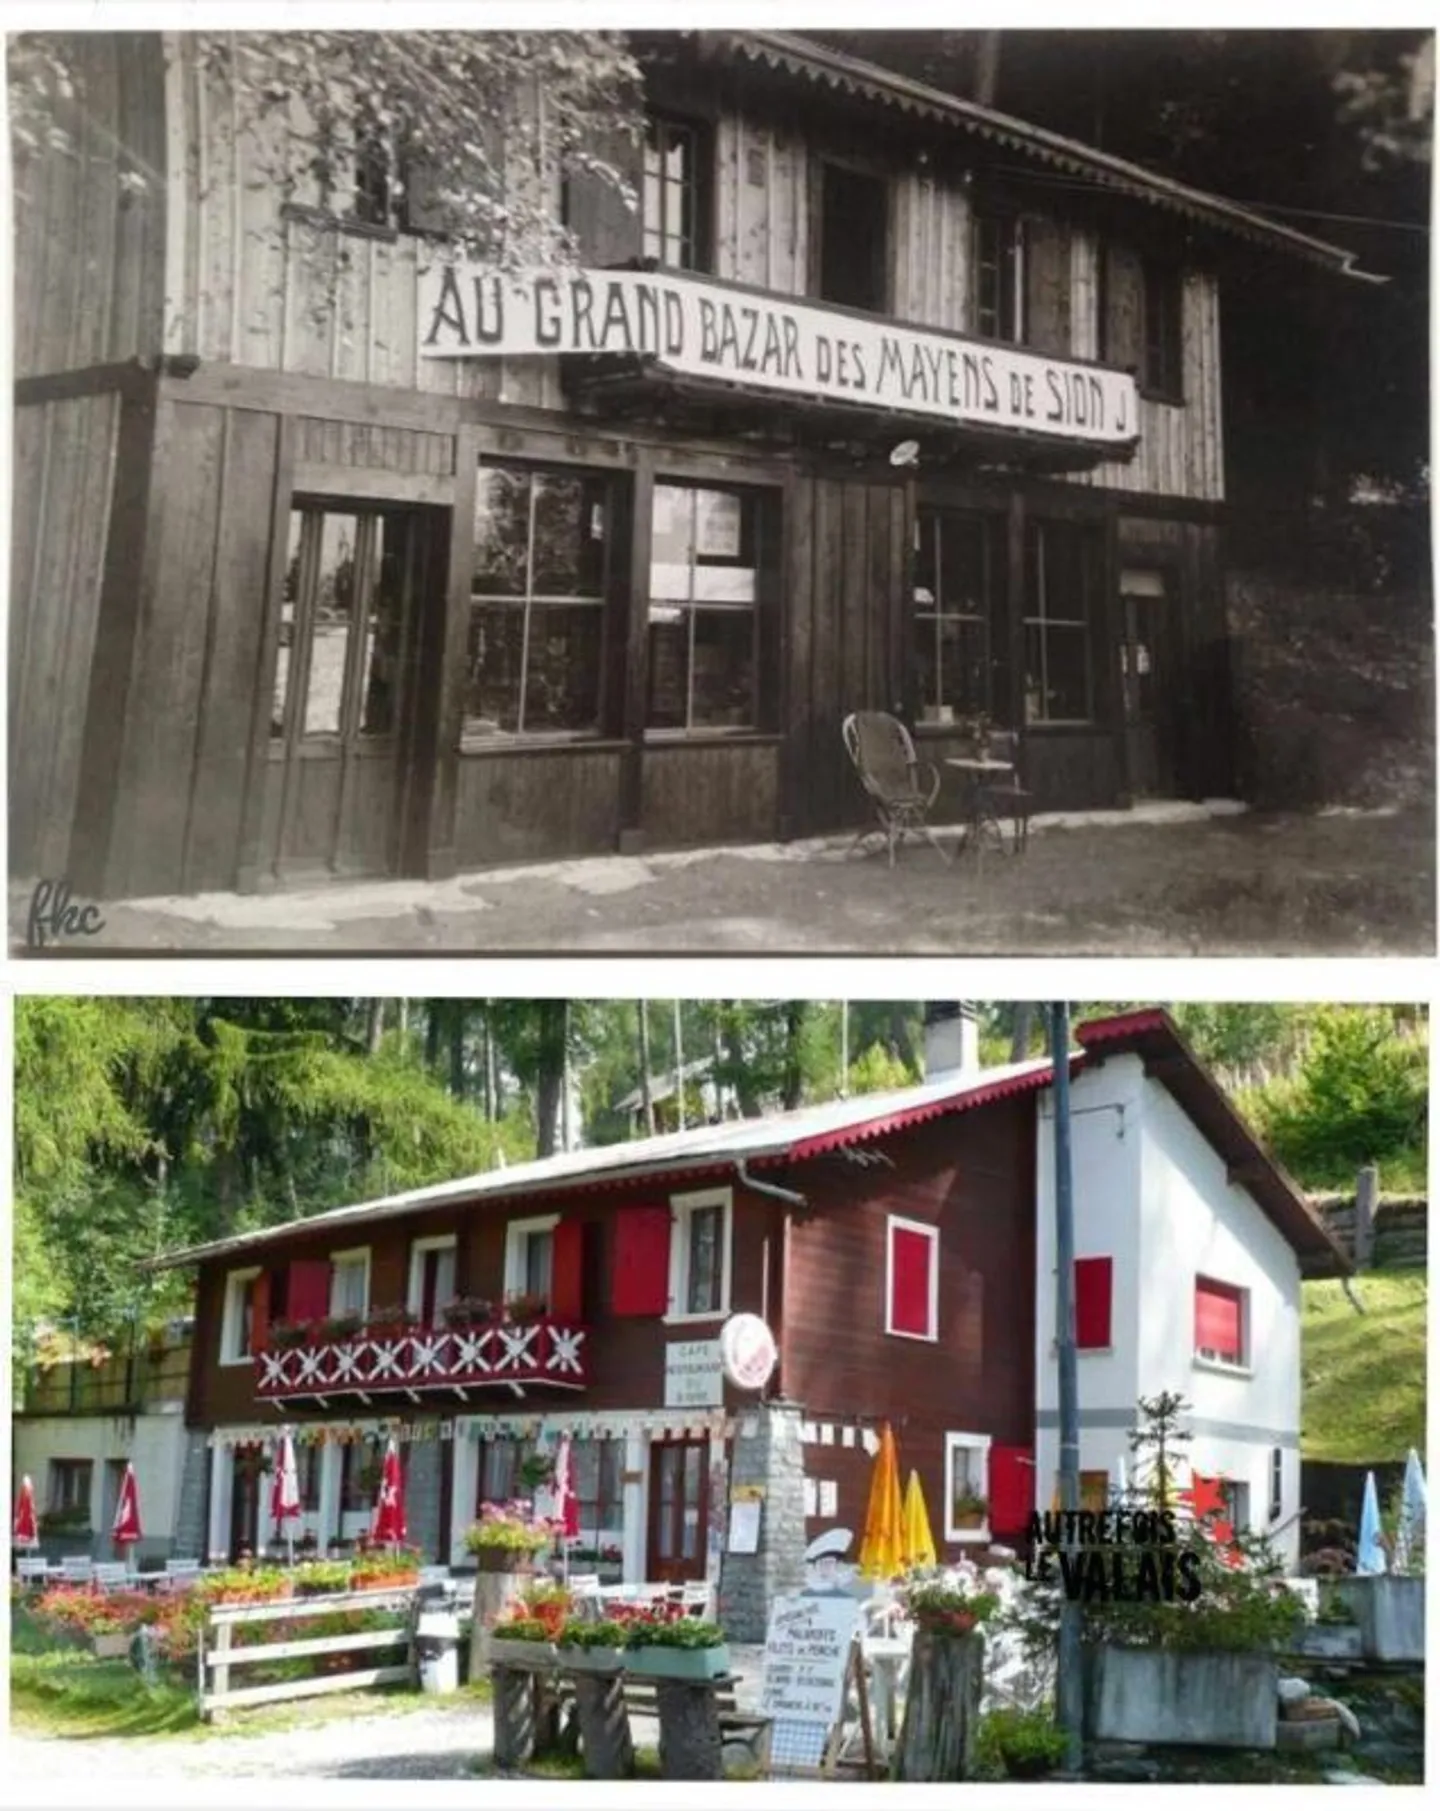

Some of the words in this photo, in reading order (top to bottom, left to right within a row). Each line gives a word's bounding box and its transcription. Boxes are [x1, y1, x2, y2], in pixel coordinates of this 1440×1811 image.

[423, 266, 504, 346] AU
[534, 276, 685, 356] GRAND
[699, 297, 803, 380] BAZAR
[815, 334, 866, 390] DES
[875, 336, 999, 412] MAYENS
[1010, 371, 1035, 418] DE
[1046, 368, 1105, 429] SION
